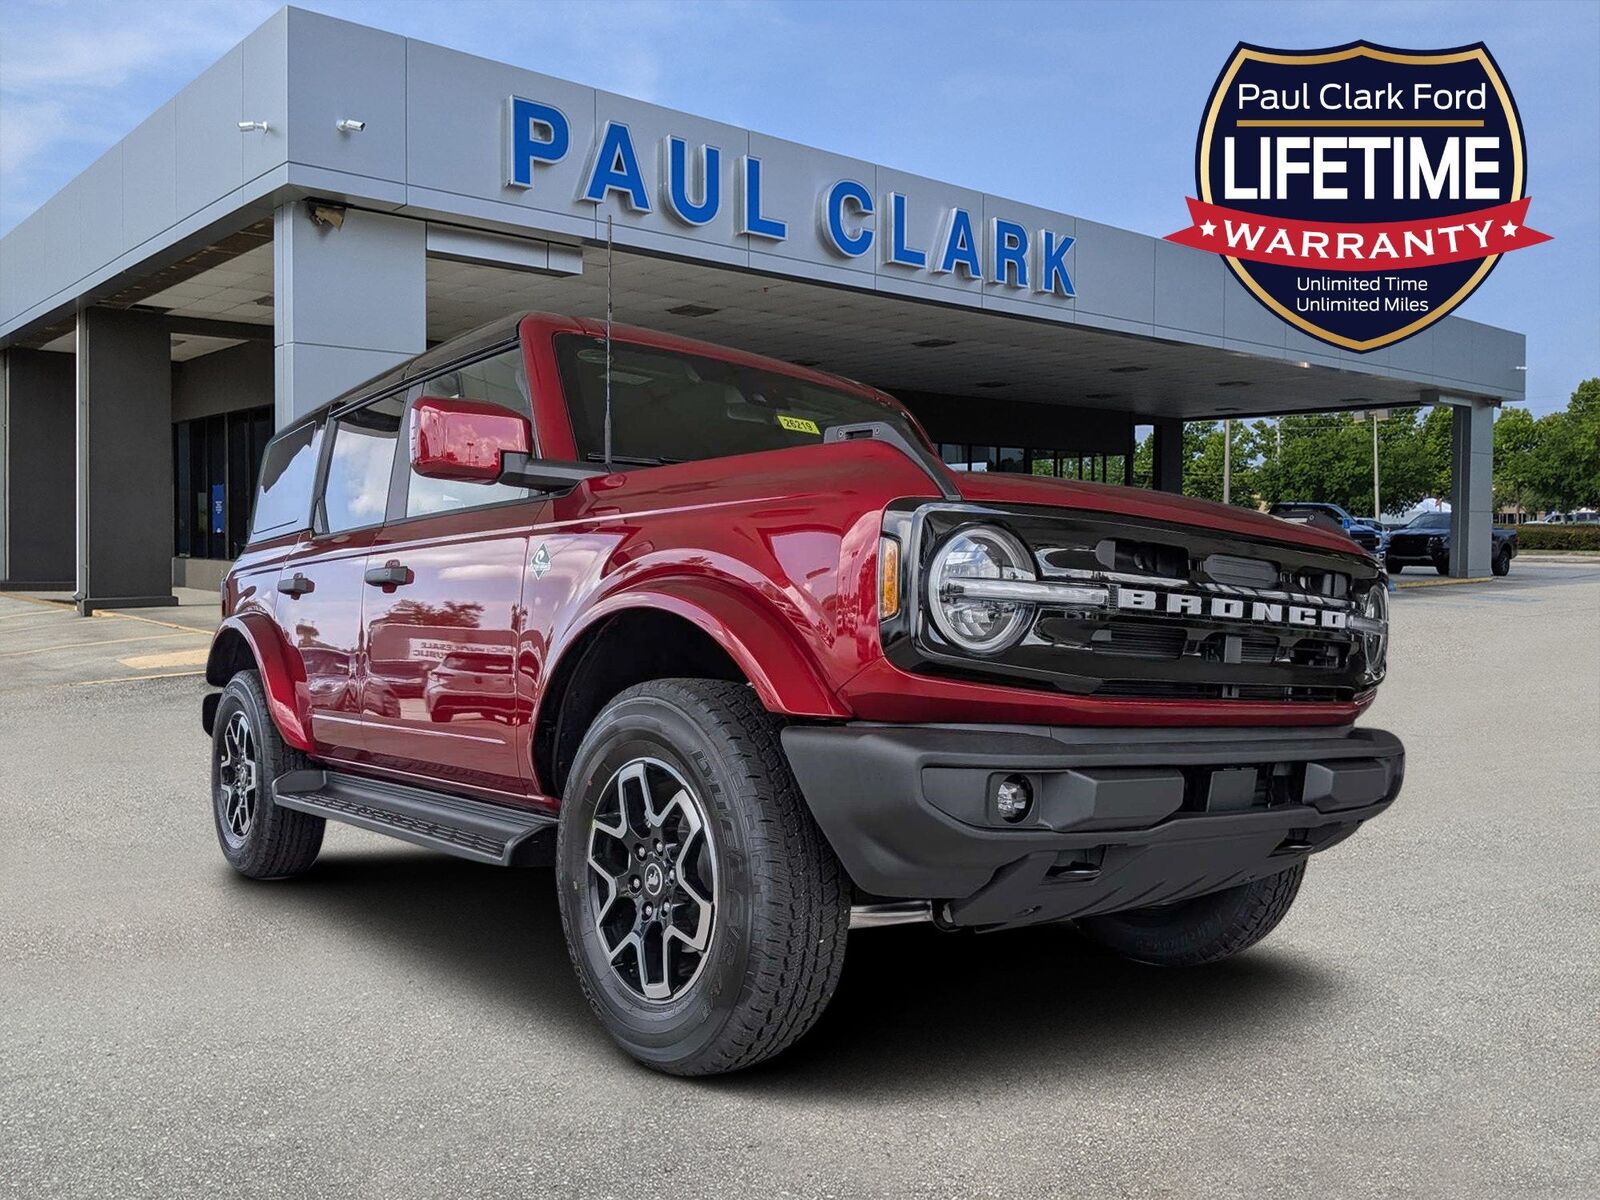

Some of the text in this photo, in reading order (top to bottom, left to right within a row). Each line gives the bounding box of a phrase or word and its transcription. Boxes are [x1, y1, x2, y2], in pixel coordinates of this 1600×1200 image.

[505, 94, 1078, 298] PAUL CLARK
[783, 418, 813, 431] 26219
[1117, 588, 1347, 629] BRONCO
